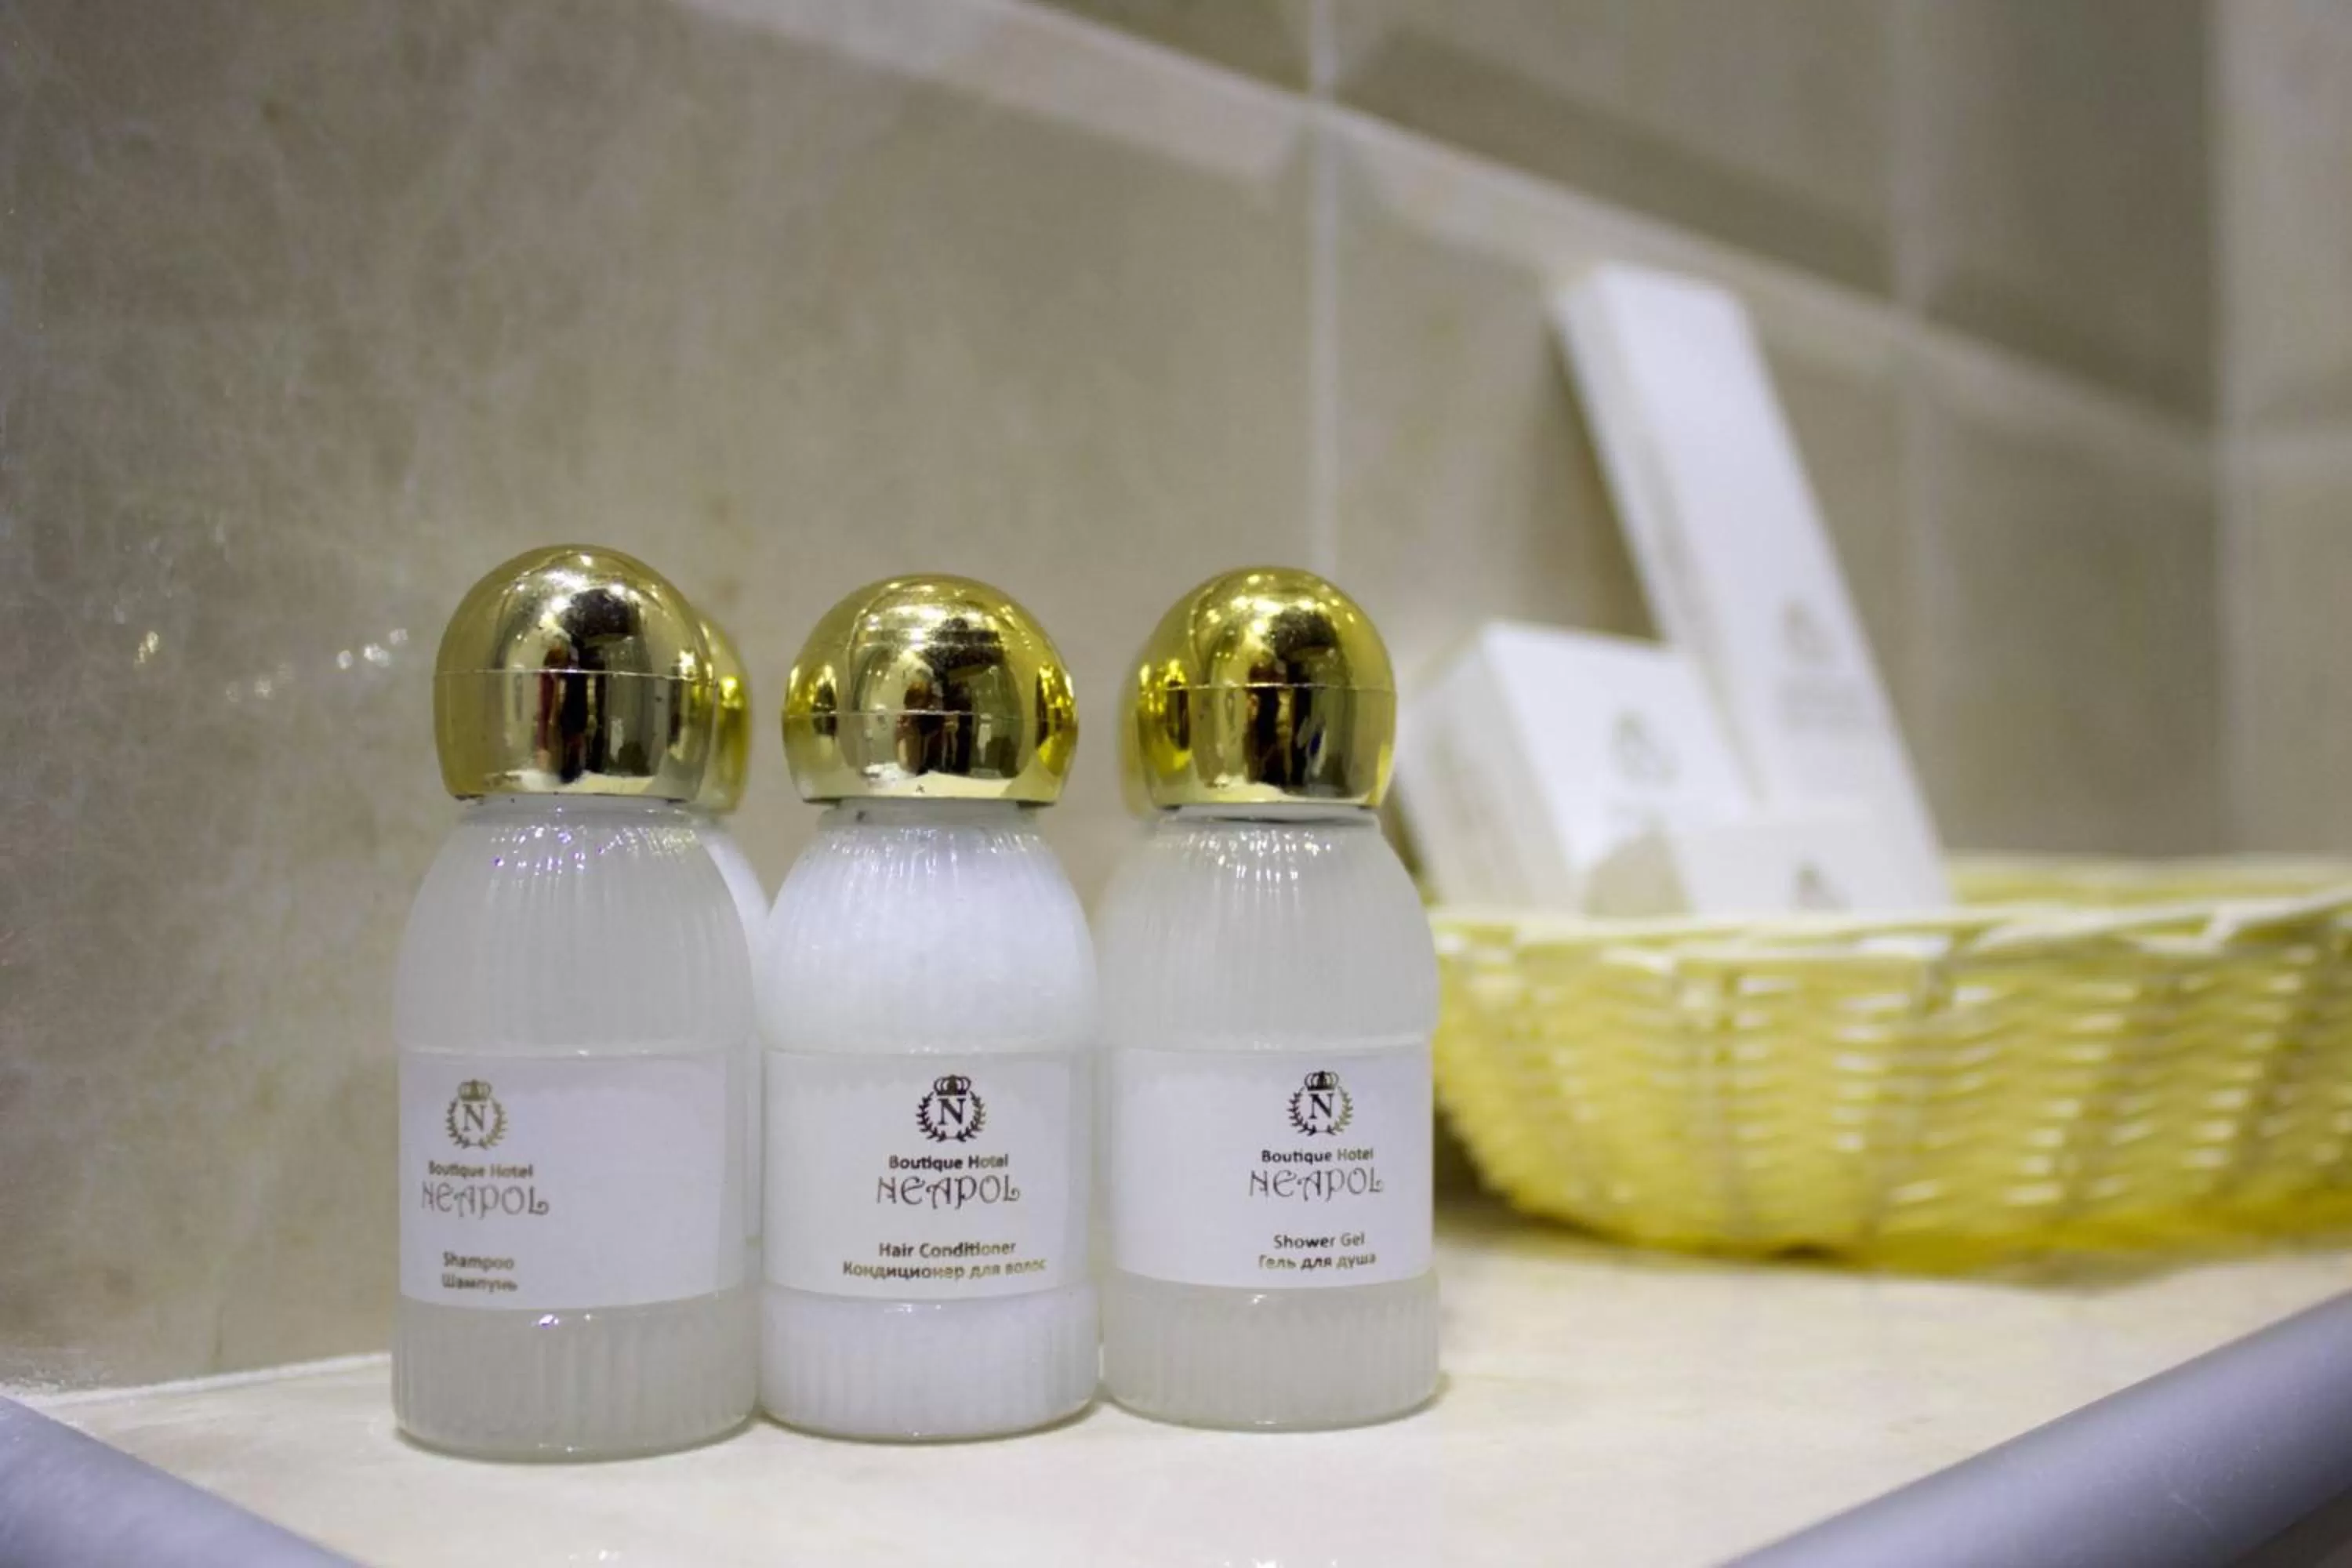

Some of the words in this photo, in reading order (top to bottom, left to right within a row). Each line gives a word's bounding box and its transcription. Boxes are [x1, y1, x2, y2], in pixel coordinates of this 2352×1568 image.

[937, 1098, 966, 1125] N
[1308, 1093, 1334, 1119] N
[889, 1155, 964, 1173] Boutique
[968, 1154, 1008, 1169] Hotel
[1261, 1149, 1332, 1165] Boutique
[1337, 1147, 1374, 1160] Hotel
[490, 1163, 534, 1178] Hotel
[879, 1243, 914, 1258] Hair
[919, 1241, 1017, 1258] Conditioner
[1273, 1234, 1335, 1249] Shower
[1341, 1232, 1365, 1247] Gel
[442, 1250, 514, 1272] Shampoo
[1258, 1254, 1297, 1269] Гель
[1300, 1257, 1332, 1272] для
[843, 1261, 965, 1280] Кондиционер
[969, 1264, 1000, 1279] для
